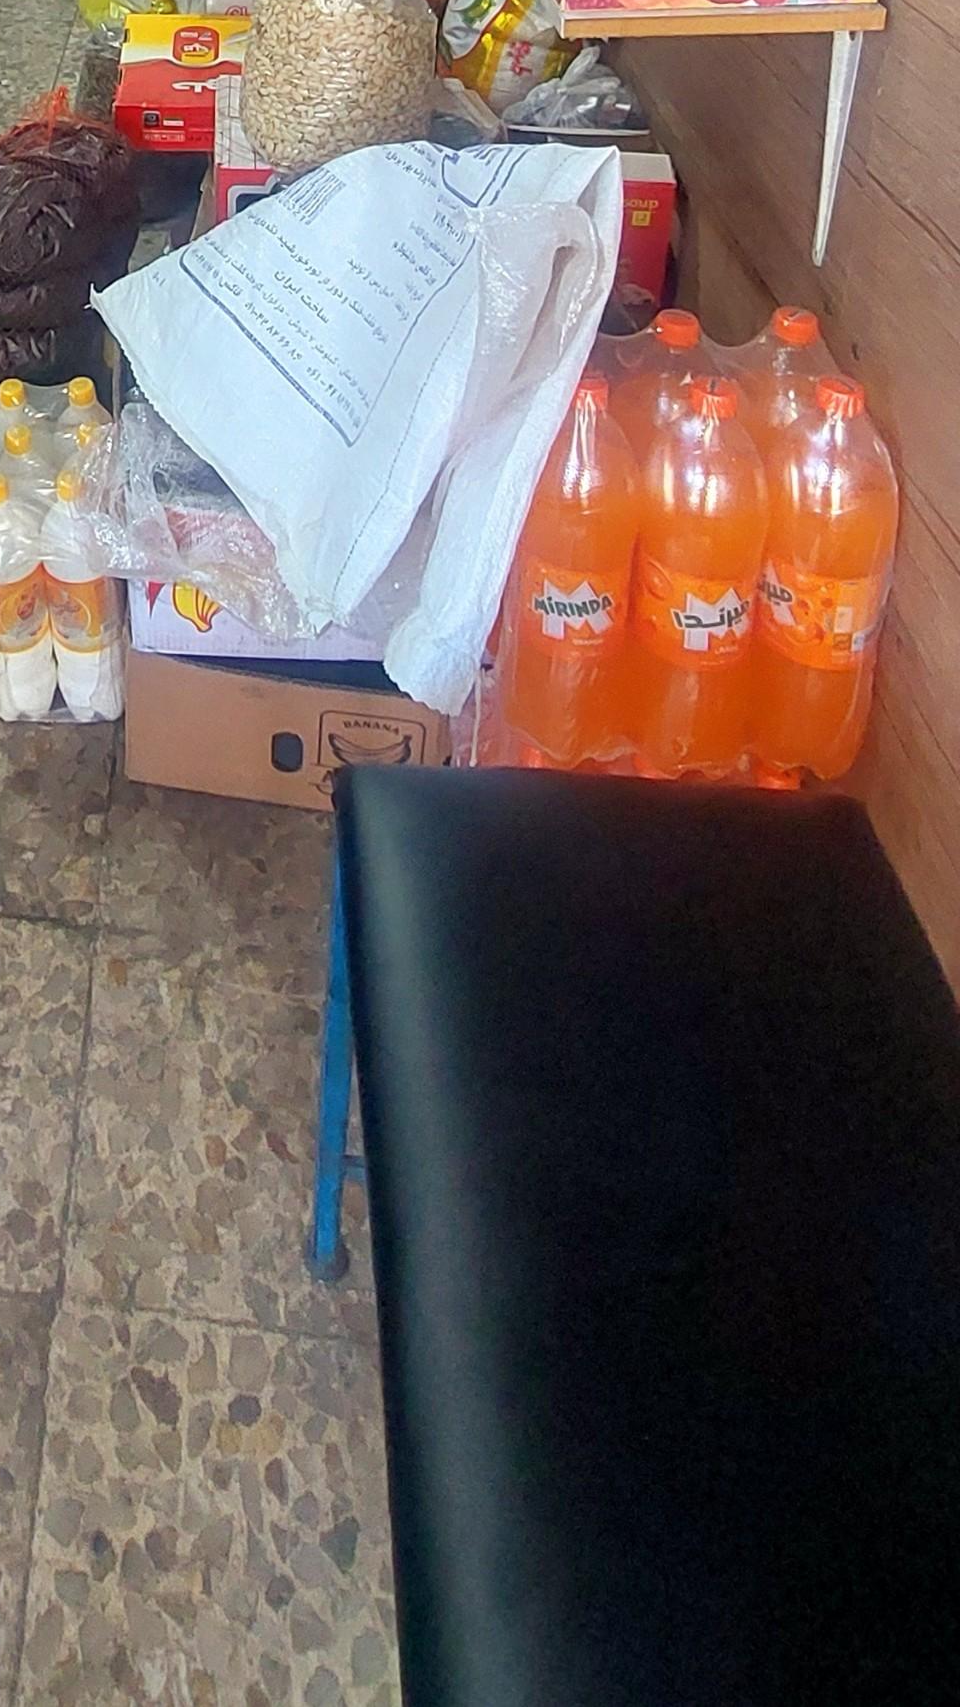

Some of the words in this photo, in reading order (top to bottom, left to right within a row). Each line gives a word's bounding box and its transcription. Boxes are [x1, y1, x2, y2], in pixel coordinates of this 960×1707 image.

[273, 270, 303, 295] ایران
[300, 294, 329, 324] ساخت
[534, 595, 614, 619] MIRINDA
[673, 599, 752, 631] میرندا
[342, 717, 402, 737] BANANA
